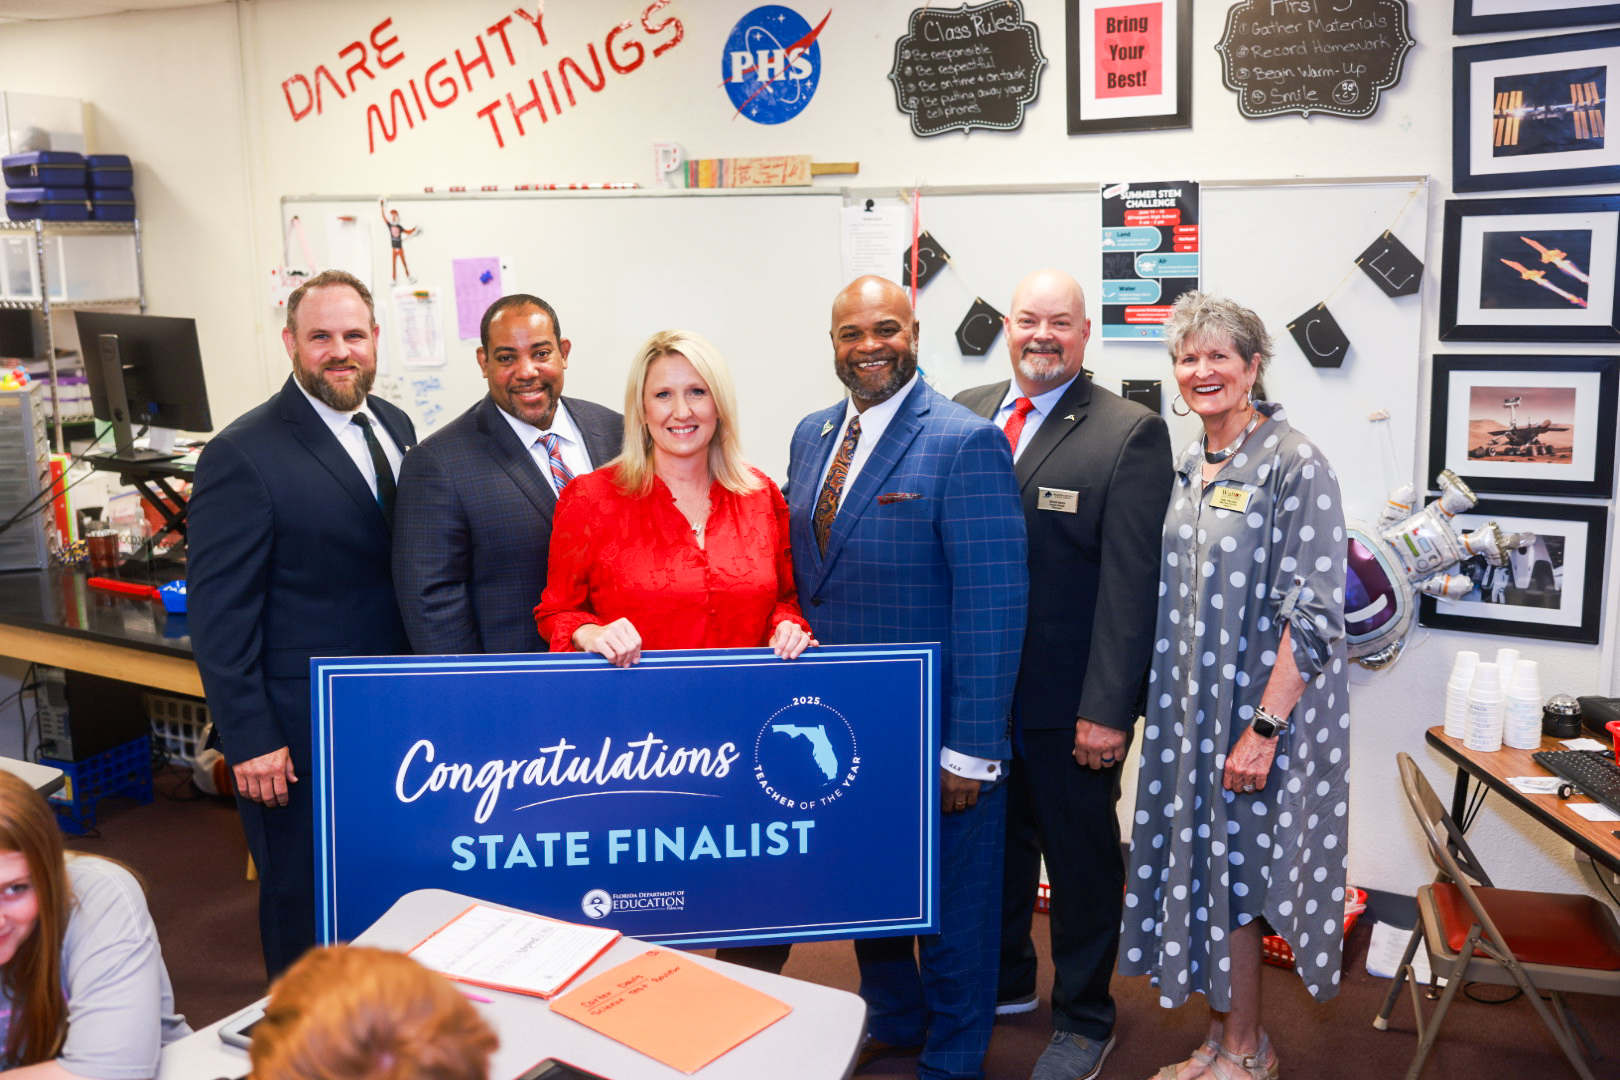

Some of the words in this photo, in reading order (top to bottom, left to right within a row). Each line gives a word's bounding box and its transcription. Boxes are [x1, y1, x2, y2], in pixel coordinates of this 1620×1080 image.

[924, 20, 972, 41] Class
[970, 12, 1017, 37] Rules
[1106, 16, 1149, 35] Bring
[1251, 20, 1301, 36] Gather
[1308, 12, 1388, 33] Materials
[911, 48, 930, 61] Be
[931, 43, 993, 62] responsible
[1109, 43, 1146, 62] Your
[1251, 40, 1307, 59] Record
[1313, 34, 1392, 55] Homework
[281, 16, 405, 123] DARE
[476, 0, 684, 149] THINGS
[730, 47, 813, 83] PHS
[915, 64, 935, 77] Be
[938, 56, 996, 76] respectful
[1254, 67, 1296, 85] Begin
[366, 0, 549, 155] MIGHTY
[918, 80, 938, 92] Be
[1107, 70, 1148, 89] Best!
[920, 95, 939, 108] Be
[941, 90, 977, 106] putting
[978, 87, 1002, 99] away
[1003, 85, 1026, 98] your
[1270, 85, 1320, 105] Smile
[1120, 189, 1157, 200] SUMMER
[1158, 188, 1182, 199] STEM
[1125, 198, 1177, 209] CHALLENGE
[905, 248, 936, 277] S
[1369, 249, 1415, 290] E
[963, 313, 992, 351] C
[1306, 319, 1340, 357] C
[792, 696, 821, 706] 2025
[395, 731, 741, 825] Congratulations
[754, 764, 795, 808] TEACHER
[799, 801, 816, 810] OF
[820, 788, 843, 806] THE
[841, 756, 861, 788] YEAR
[451, 830, 591, 871] STATE
[609, 818, 816, 864] FINALIST
[613, 896, 685, 910] EDUCATION
